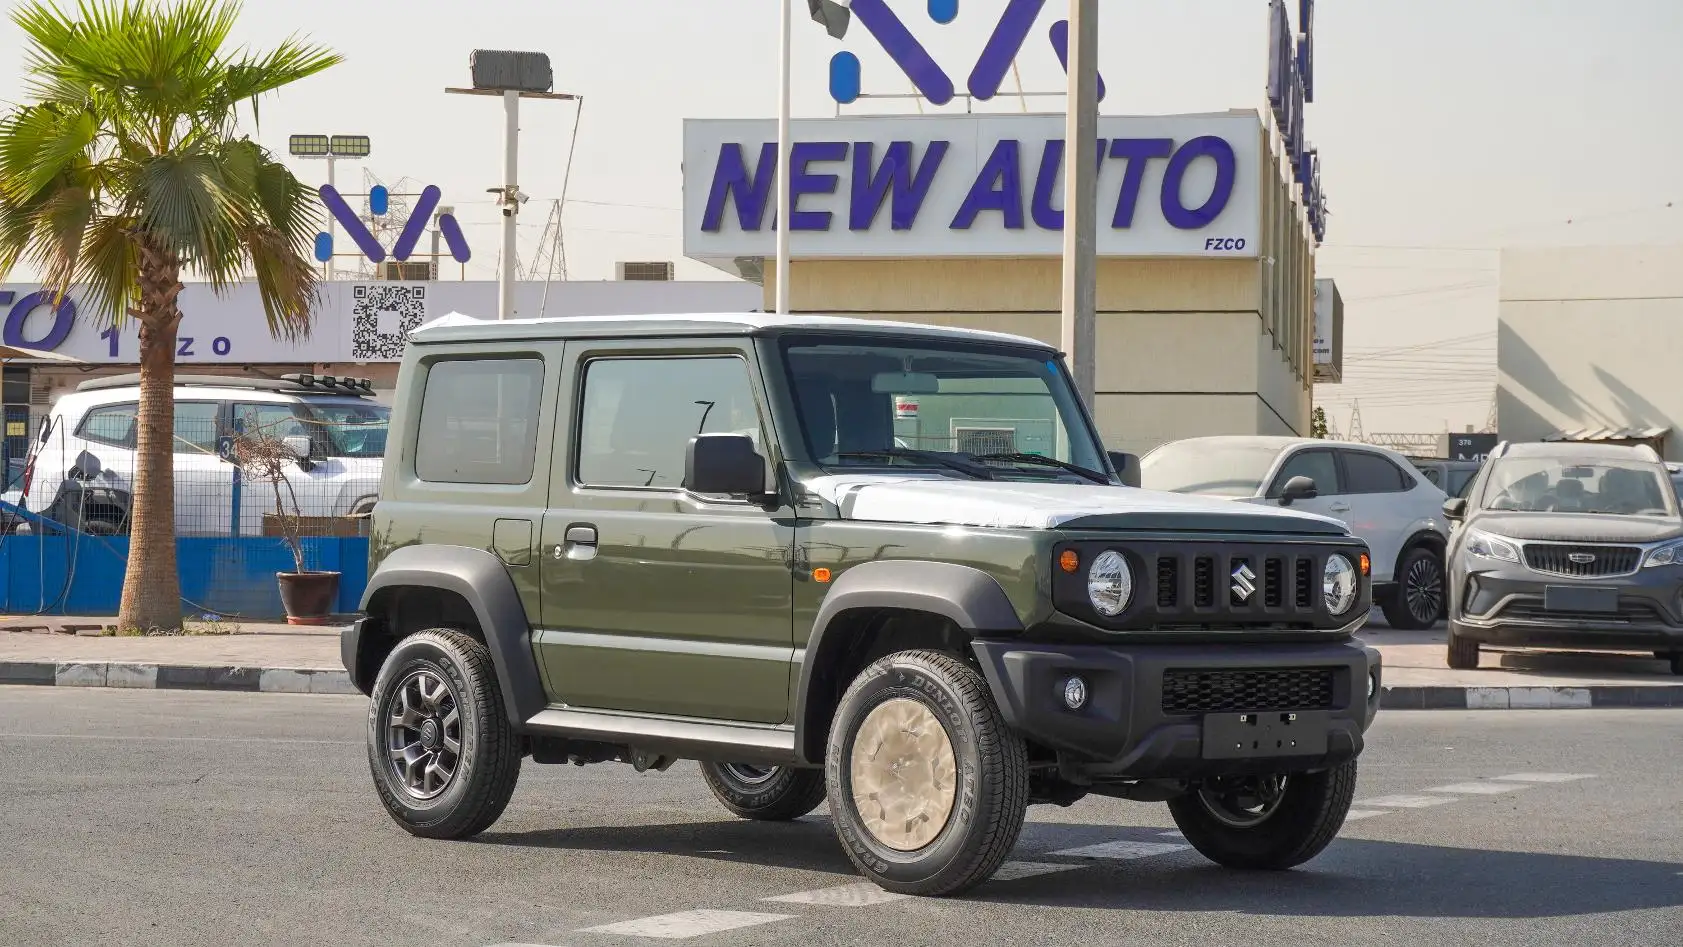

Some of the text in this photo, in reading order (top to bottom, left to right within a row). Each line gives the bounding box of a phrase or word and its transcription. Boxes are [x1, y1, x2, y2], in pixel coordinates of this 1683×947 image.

[701, 134, 1237, 232] NEW AUTO
[1204, 238, 1245, 251] FZCO
[912, 674, 968, 744] DUNLOP
